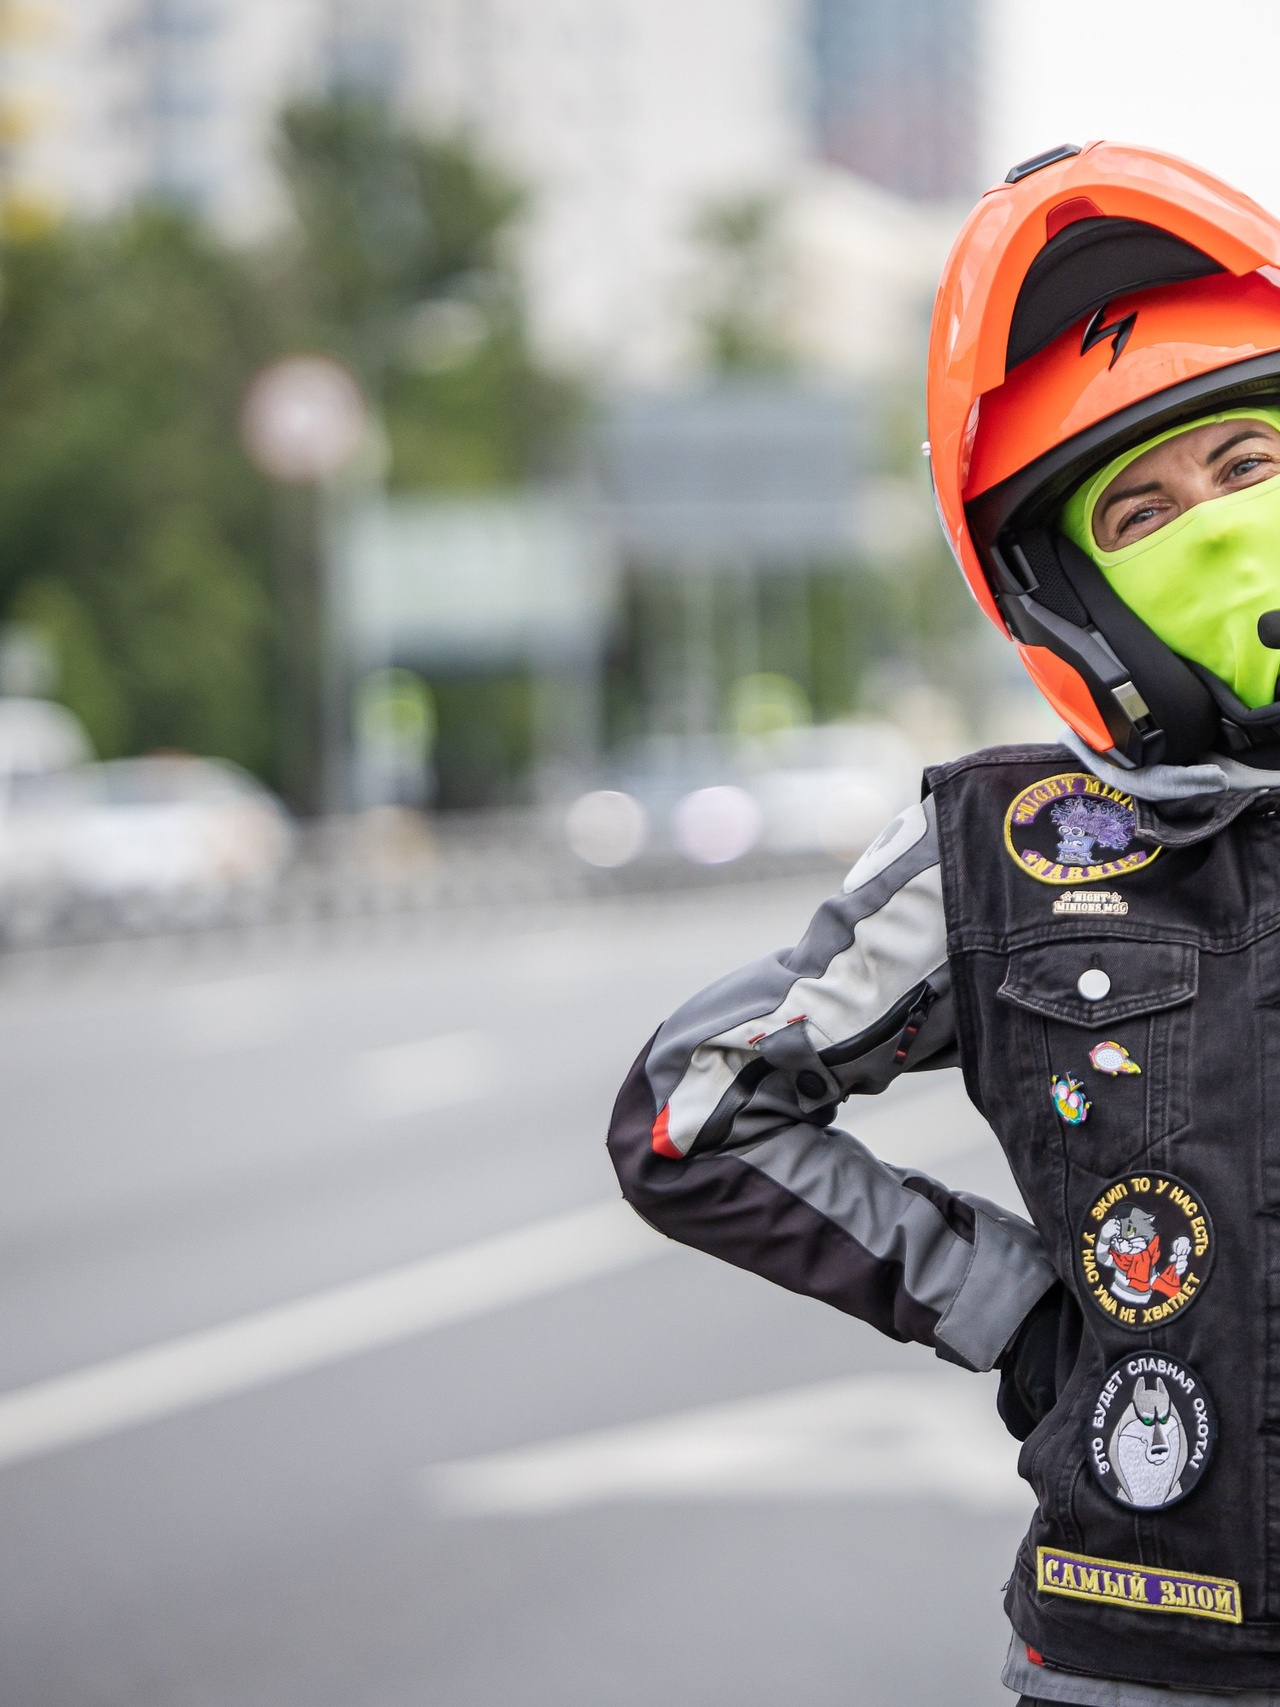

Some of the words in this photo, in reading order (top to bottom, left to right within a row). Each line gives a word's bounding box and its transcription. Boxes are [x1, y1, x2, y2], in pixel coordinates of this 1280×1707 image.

[1020, 777, 1076, 816] NIGHT
[1033, 854, 1134, 879] NARNIA
[1056, 902, 1102, 911] MINIONS
[1075, 893, 1108, 902] NIGHT
[1091, 1183, 1128, 1221] ЭКИП
[1131, 1177, 1150, 1192] ТО
[1155, 1179, 1169, 1194] У
[1169, 1186, 1198, 1217] НАС
[1190, 1216, 1209, 1257] ЕСТЬ
[1082, 1231, 1096, 1247] У
[1082, 1249, 1100, 1284] НАС
[1094, 1284, 1118, 1315] УМА
[1119, 1306, 1137, 1324] НЕ
[1142, 1272, 1200, 1323] ХВАТАЕТ
[1127, 1357, 1196, 1394] СЛАВНАЯ
[1093, 1370, 1123, 1429] БУДЕТ
[1092, 1437, 1111, 1475] ЭТО
[1045, 1559, 1149, 1602] САМЫЙ
[1160, 1580, 1235, 1614] ЗЛОЙ
